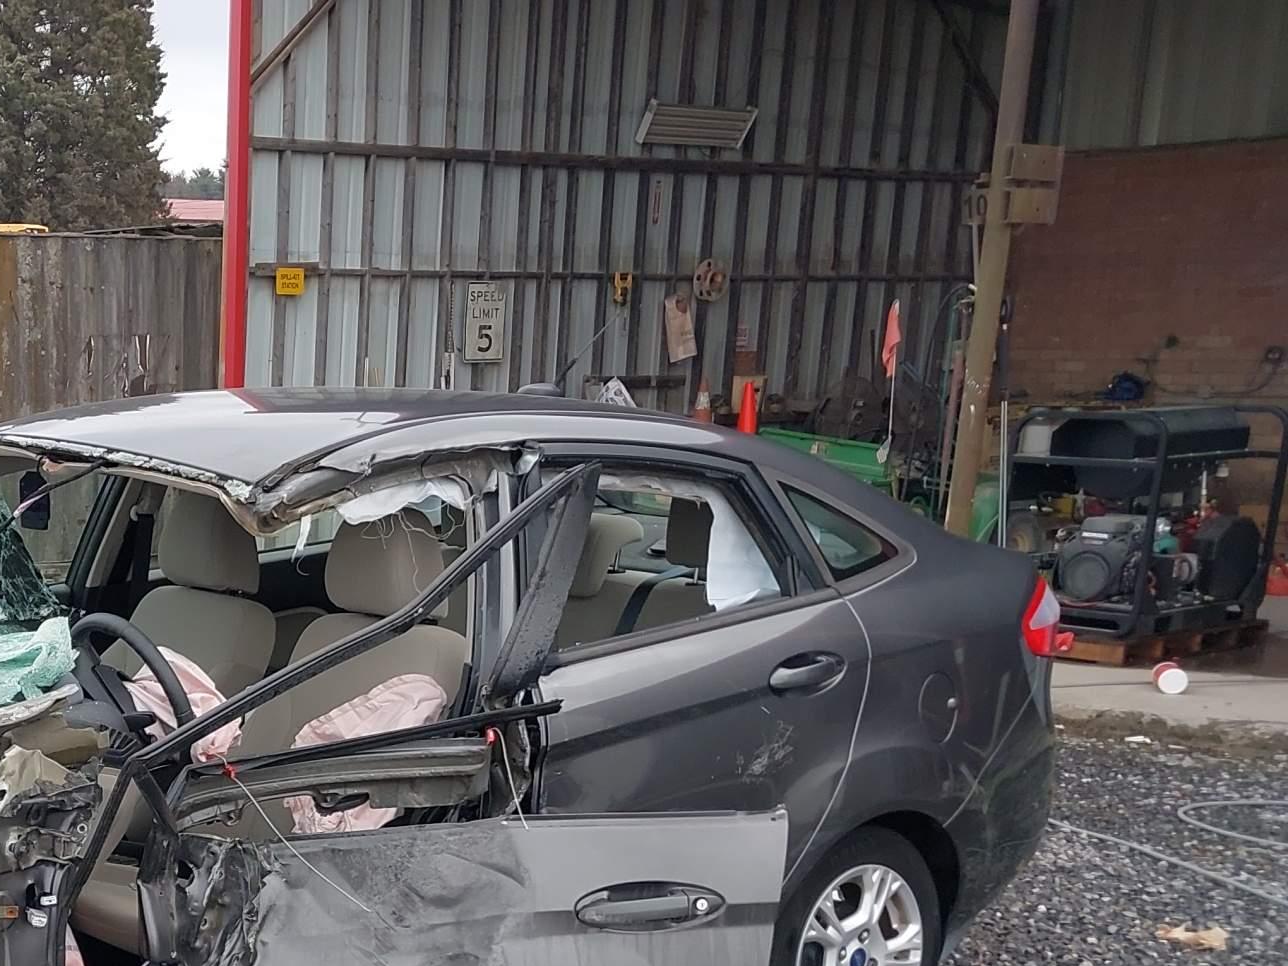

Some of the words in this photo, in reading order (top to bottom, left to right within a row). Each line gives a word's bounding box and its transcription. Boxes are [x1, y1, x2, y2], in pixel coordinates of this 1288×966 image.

[470, 290, 504, 303] SPEED
[472, 307, 500, 319] LIMIT
[477, 324, 493, 353] 5
